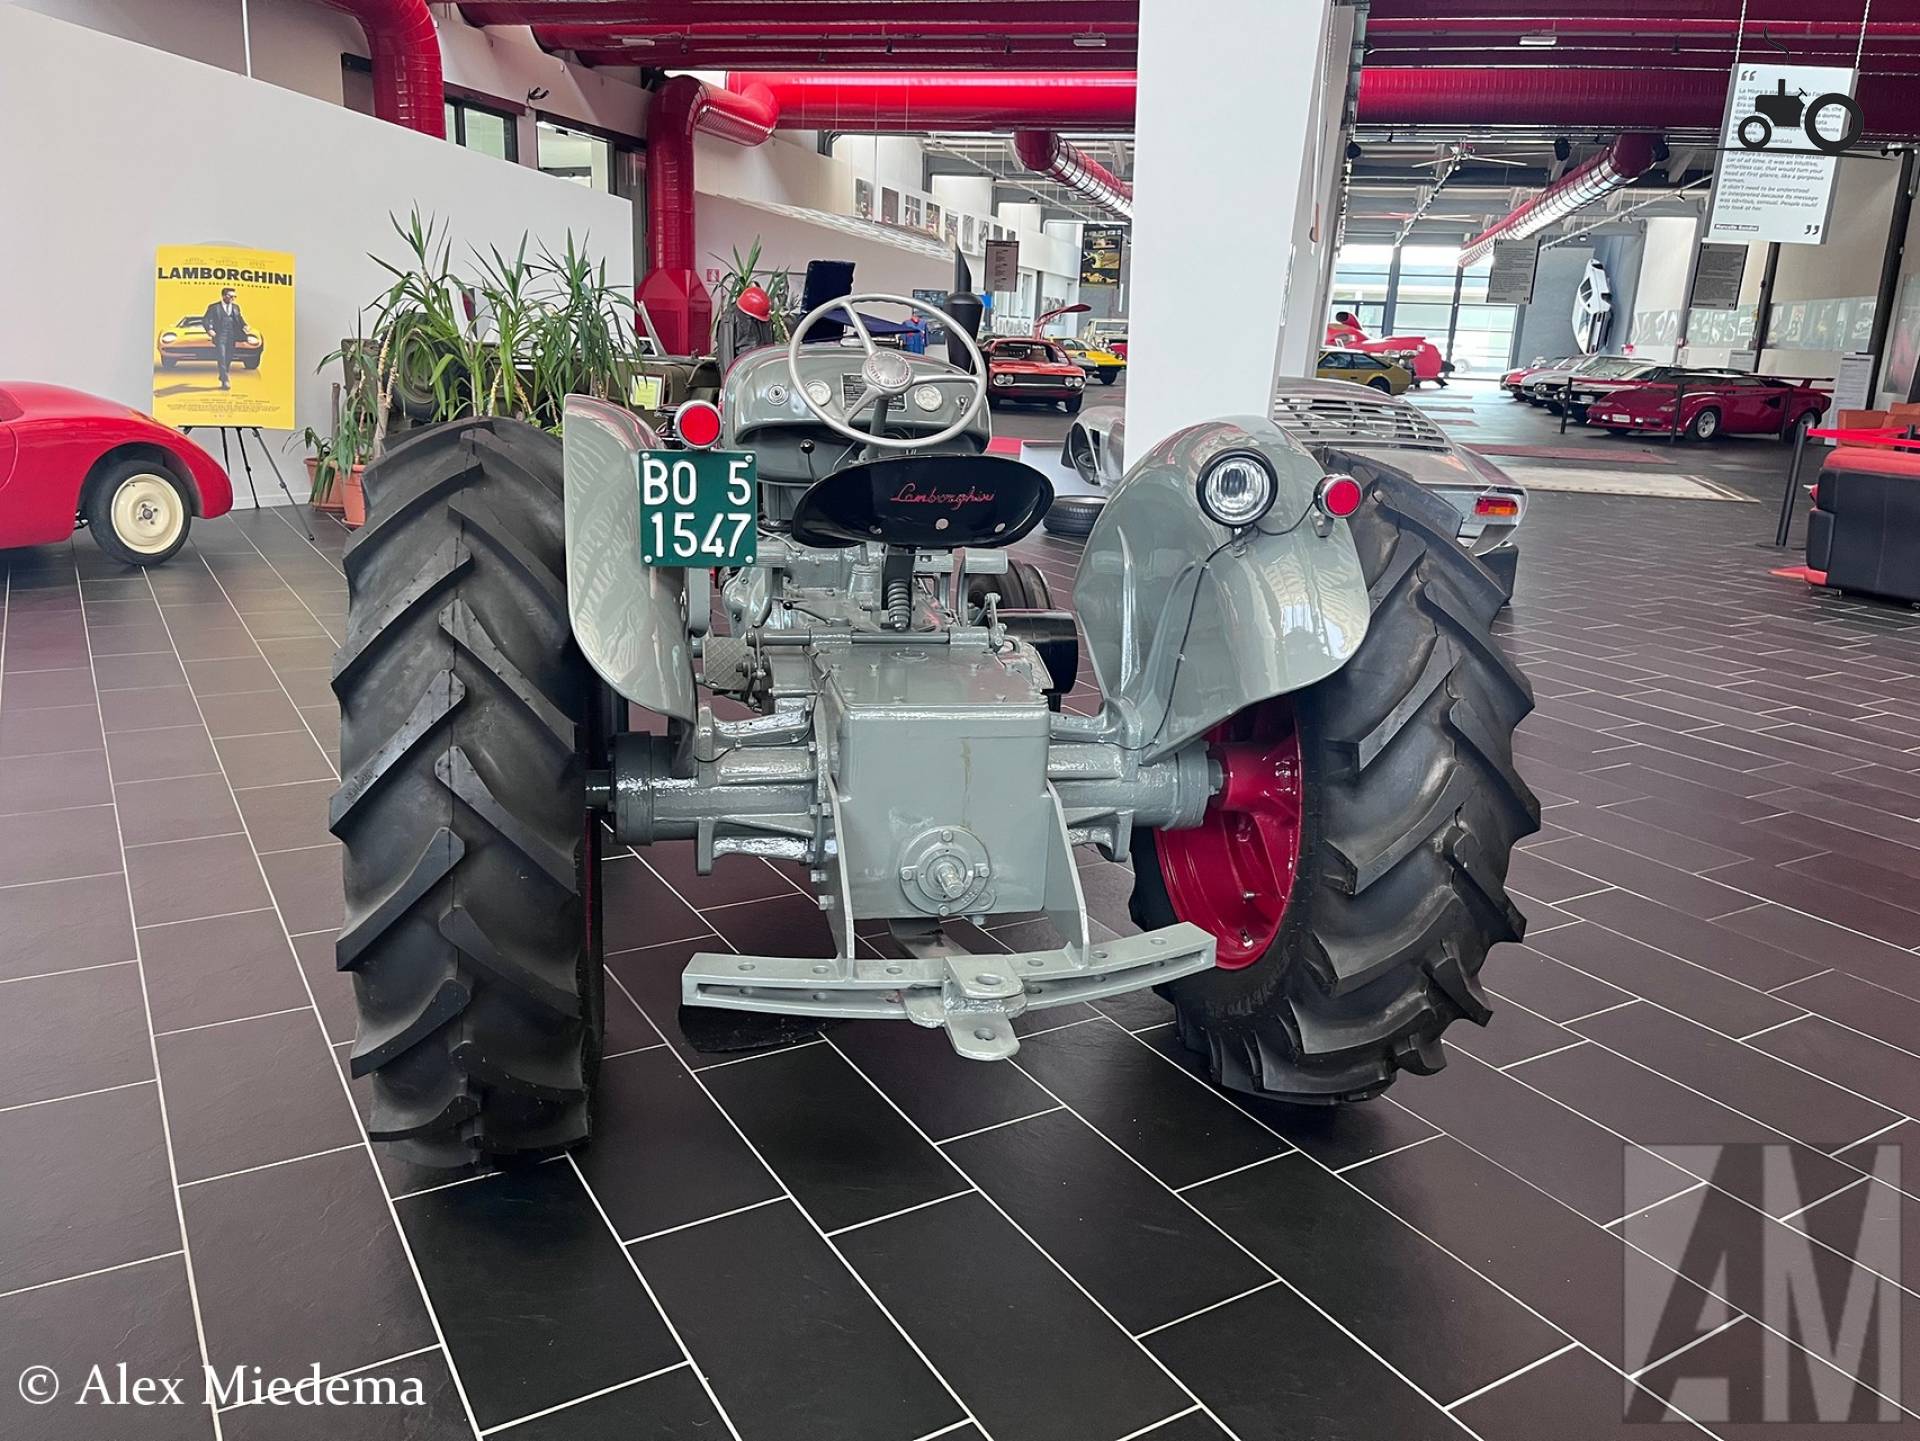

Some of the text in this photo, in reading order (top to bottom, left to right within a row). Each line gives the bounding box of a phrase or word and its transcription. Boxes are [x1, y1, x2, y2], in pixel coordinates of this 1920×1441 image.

[157, 267, 293, 287] LAMBORGHINI
[643, 459, 751, 506] BO 5
[650, 511, 752, 558] 1547
